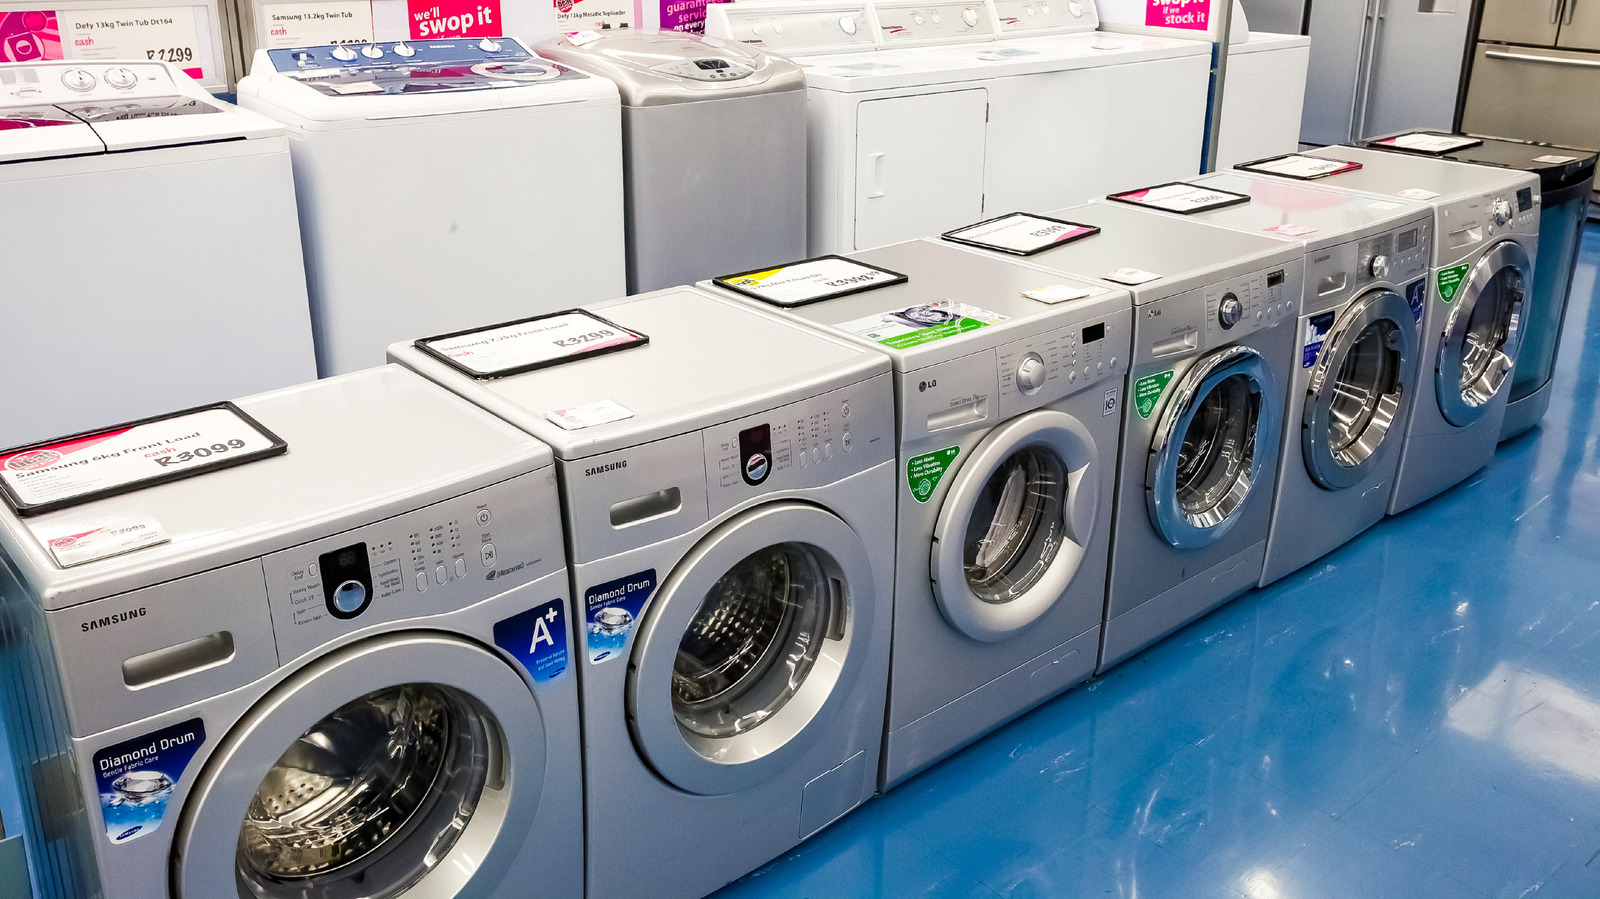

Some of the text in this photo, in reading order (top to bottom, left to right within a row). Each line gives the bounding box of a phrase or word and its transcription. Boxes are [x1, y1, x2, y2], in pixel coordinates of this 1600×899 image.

[303, 12, 325, 20] 13.2kg
[414, 6, 440, 21] we'll
[678, 8, 707, 23] servic
[1163, 6, 1169, 14] if
[75, 22, 94, 30] Defy
[96, 21, 115, 29] 13kg
[151, 18, 173, 26] Dt164
[419, 5, 493, 37] swop it
[684, 20, 705, 30] every
[1165, 11, 1205, 25] stock it
[270, 27, 287, 36] cash
[74, 36, 94, 46] cash
[441, 339, 489, 352] Samsung
[552, 328, 615, 348] R3299
[928, 379, 937, 388] LG
[15, 432, 201, 479] Samsung 6kg Front Load
[144, 447, 177, 458] cash
[154, 438, 246, 467] R3099
[585, 460, 627, 476] SAMSUNG
[923, 461, 940, 469] Vibration
[588, 580, 650, 605] Diamond Drum
[81, 607, 147, 632] SAMSUNG
[529, 607, 558, 654] A+
[99, 732, 195, 771] Diamond Drum
[102, 755, 159, 779] Gentle Fabric Care
